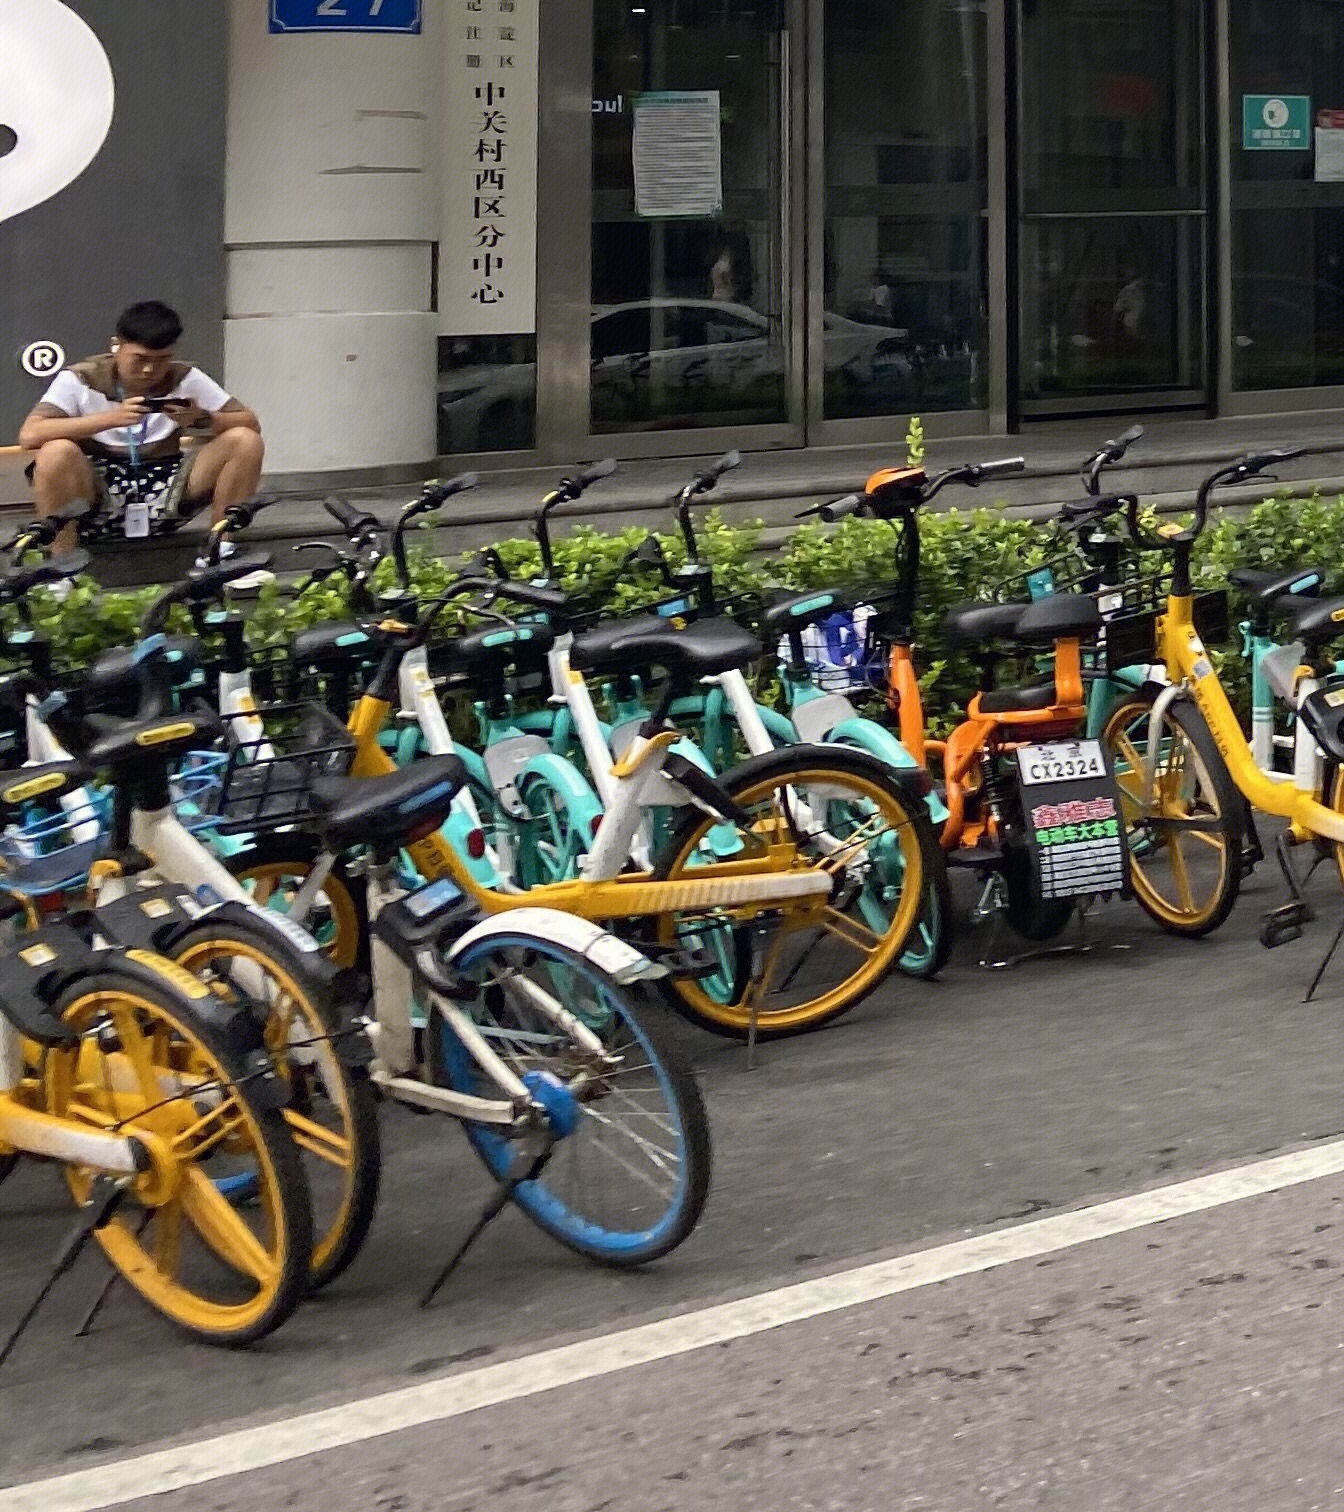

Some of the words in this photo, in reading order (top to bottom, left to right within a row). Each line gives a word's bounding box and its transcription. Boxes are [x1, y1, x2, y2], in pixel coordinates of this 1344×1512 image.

[470, 81, 508, 306] 中关村西区分中心
[1031, 757, 1099, 780] CX2324
